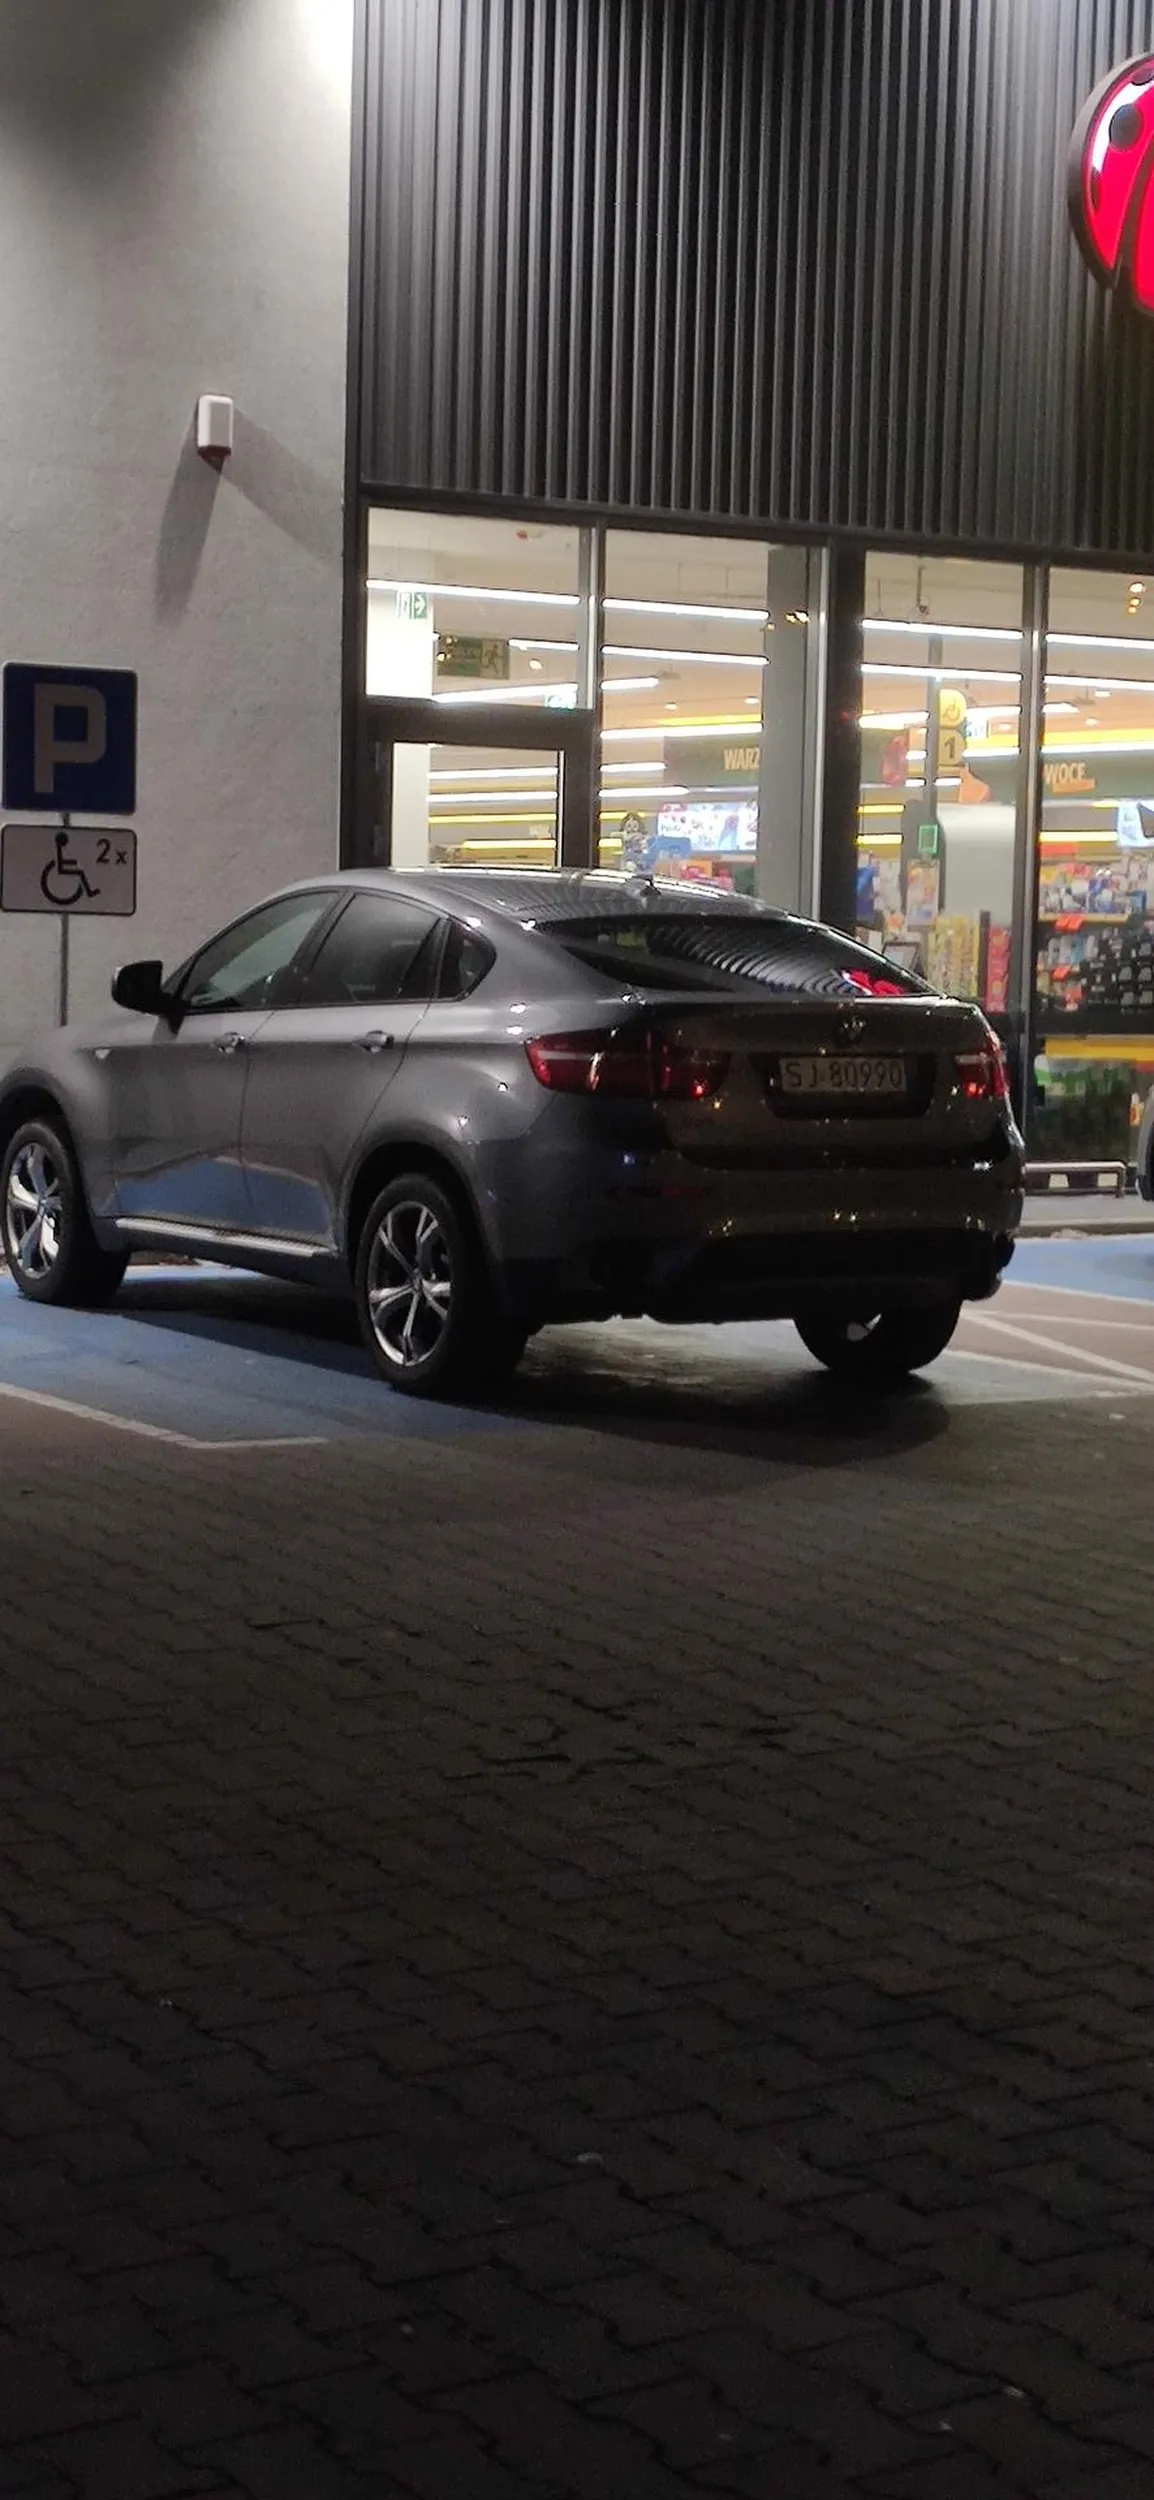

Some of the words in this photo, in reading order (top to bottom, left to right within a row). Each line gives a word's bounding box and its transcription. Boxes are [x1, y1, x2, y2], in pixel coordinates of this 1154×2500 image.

[34, 683, 107, 793] P
[944, 736, 956, 759] 1
[828, 1060, 903, 1088] 80990
